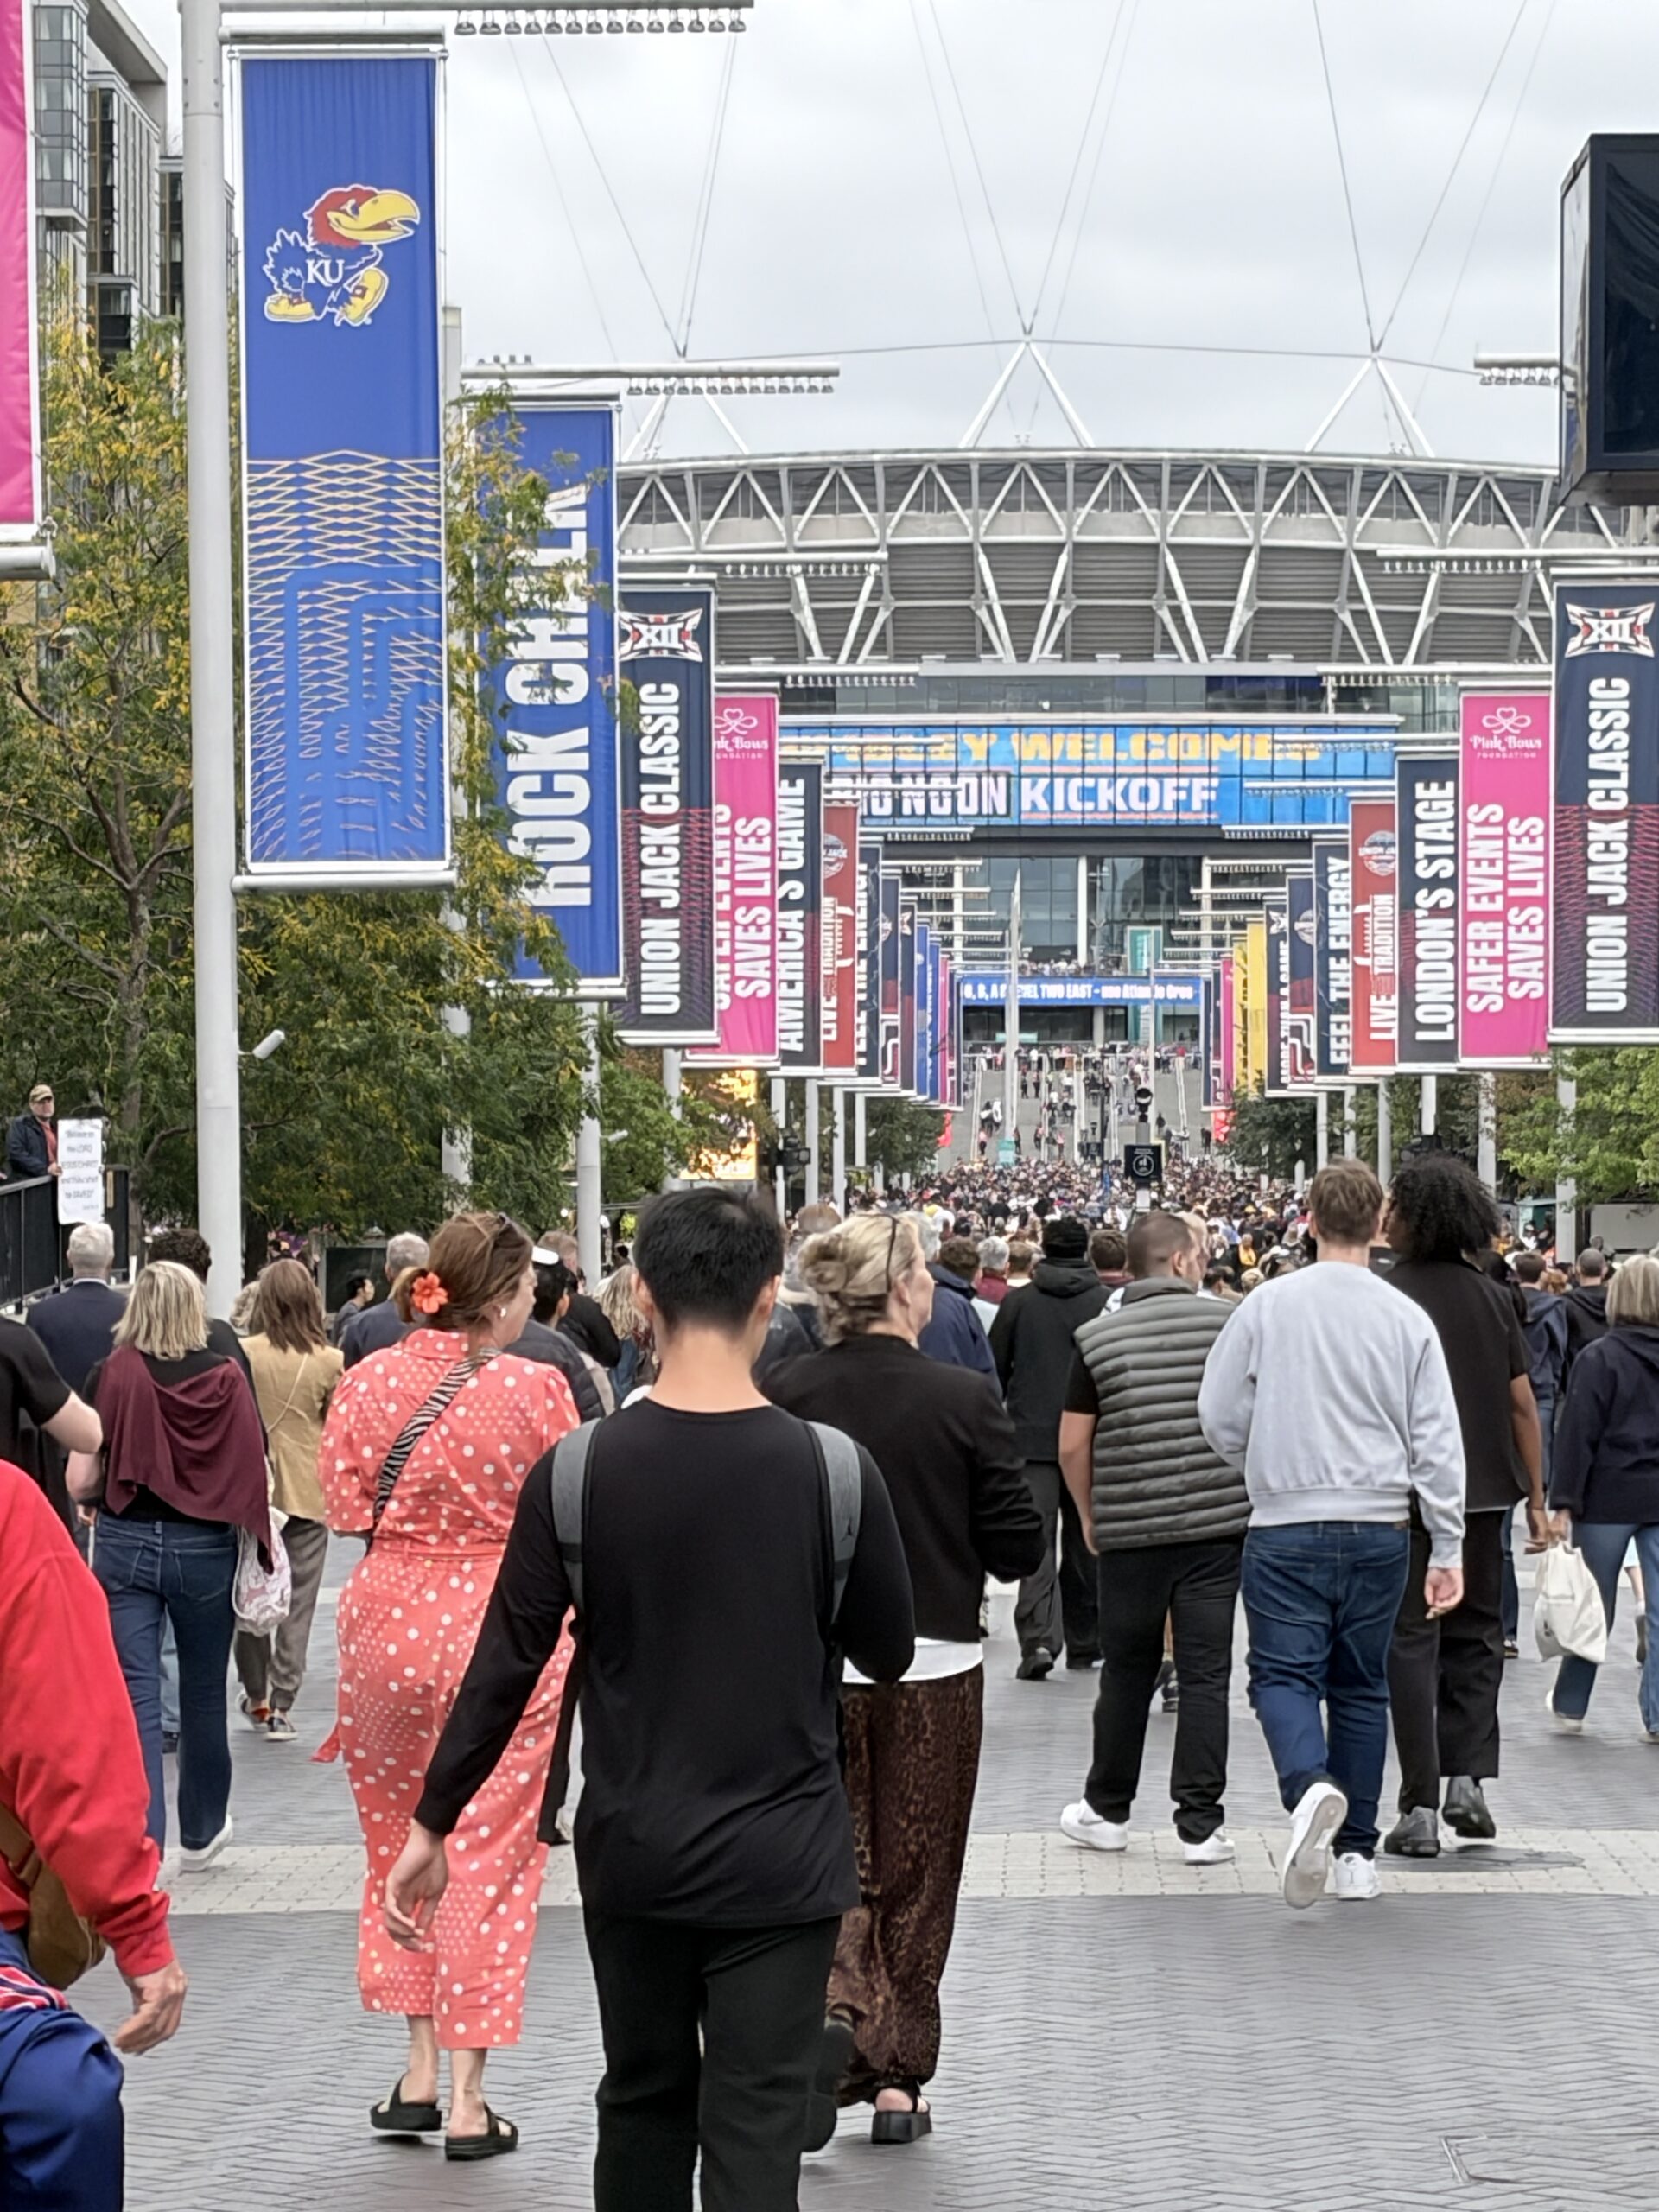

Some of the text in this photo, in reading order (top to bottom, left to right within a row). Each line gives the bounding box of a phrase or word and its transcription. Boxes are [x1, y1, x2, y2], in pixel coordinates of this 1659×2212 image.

[306, 258, 345, 287] KU
[1020, 777, 1220, 812] KICKOFF
[1504, 735, 1542, 749] Bows
[639, 683, 681, 1014] UNION JACK CLASSIC
[734, 817, 772, 998] SAVES LIVES
[778, 779, 805, 1052] AMERICAS GAME
[1373, 894, 1395, 976] TRADITION
[1414, 780, 1454, 1041] LONDON'S STAGE
[1466, 804, 1503, 1014] SAFER EVENTS
[1507, 817, 1545, 1001] SAVES LIVES
[1586, 677, 1630, 1012] UNION JACK CLASSIC
[1370, 994, 1396, 1041] LIVE
